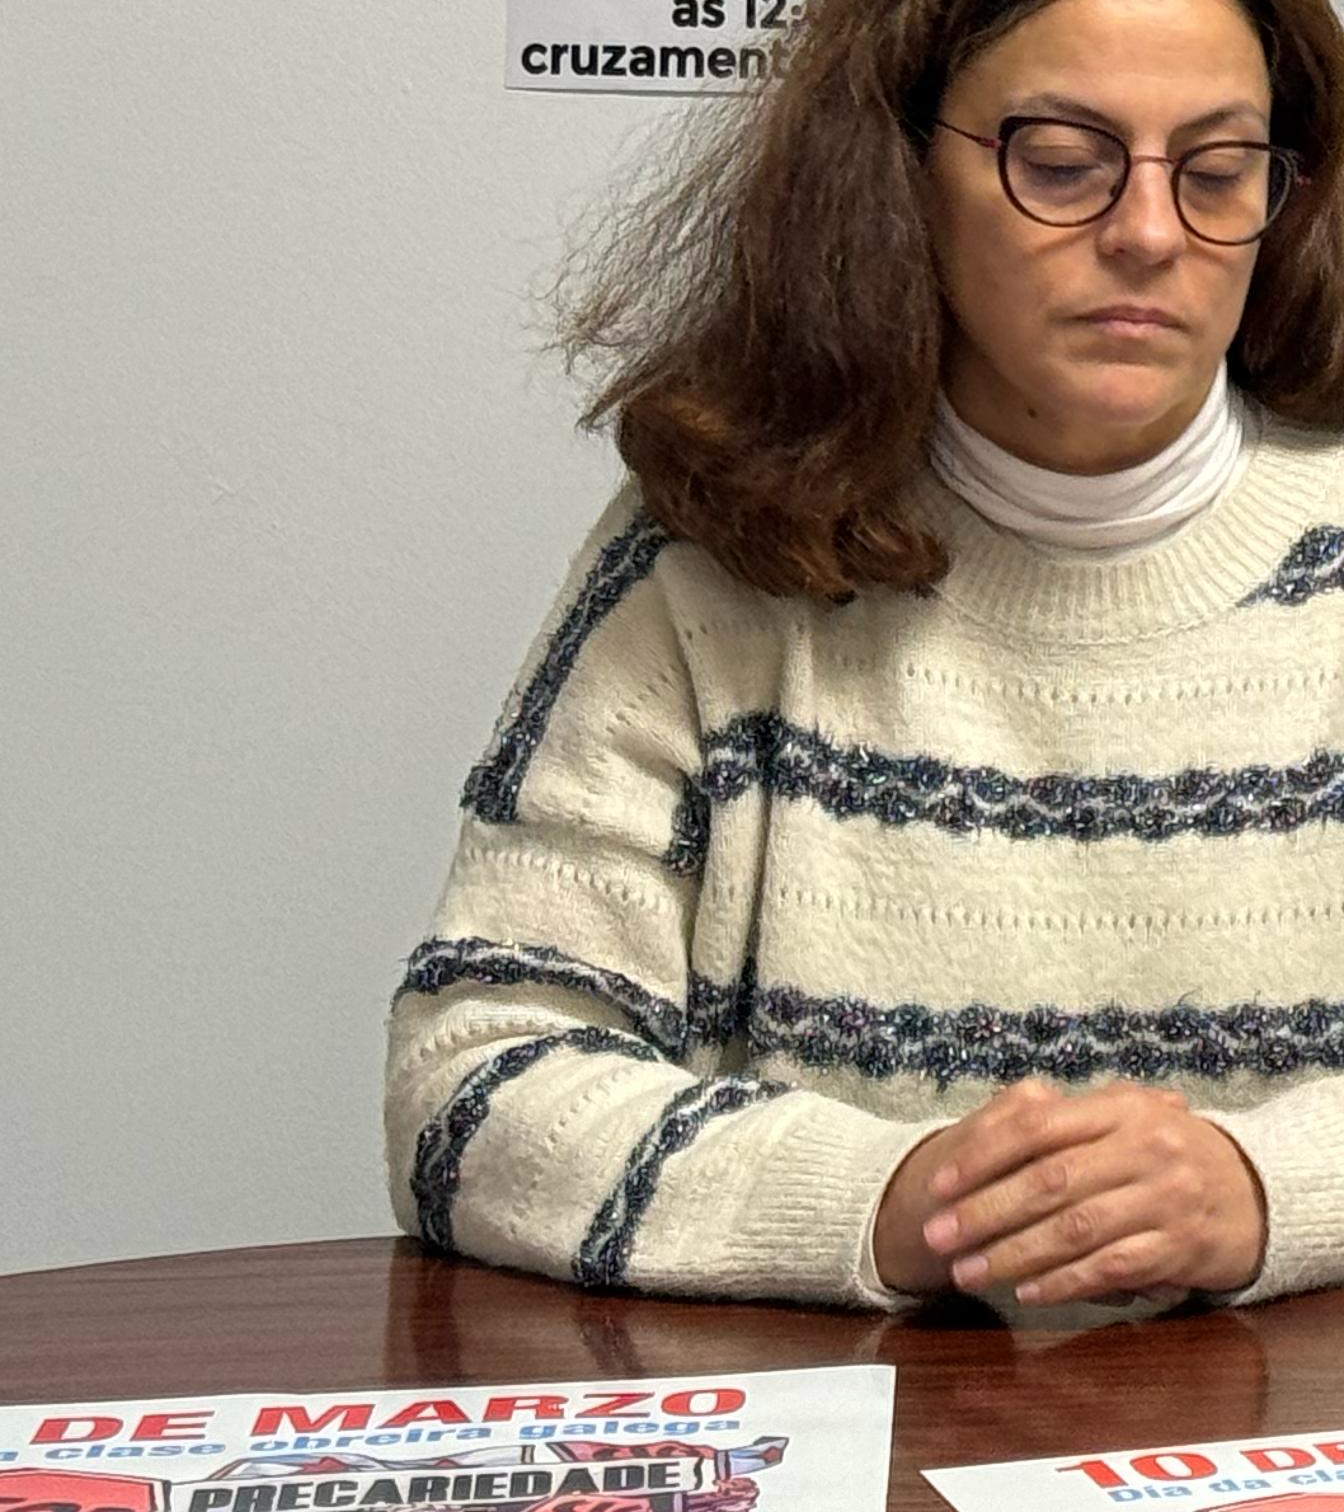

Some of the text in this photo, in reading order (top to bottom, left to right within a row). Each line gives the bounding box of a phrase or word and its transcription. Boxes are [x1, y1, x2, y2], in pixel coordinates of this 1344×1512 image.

[30, 1389, 747, 1445] DE MARZO
[45, 1420, 740, 1459] clase obreira galega
[188, 1462, 680, 1512] PRECARIEDADE
[1055, 1452, 1218, 1489] 10
[1107, 1484, 1193, 1502] Día
[1209, 1478, 1272, 1493] da
